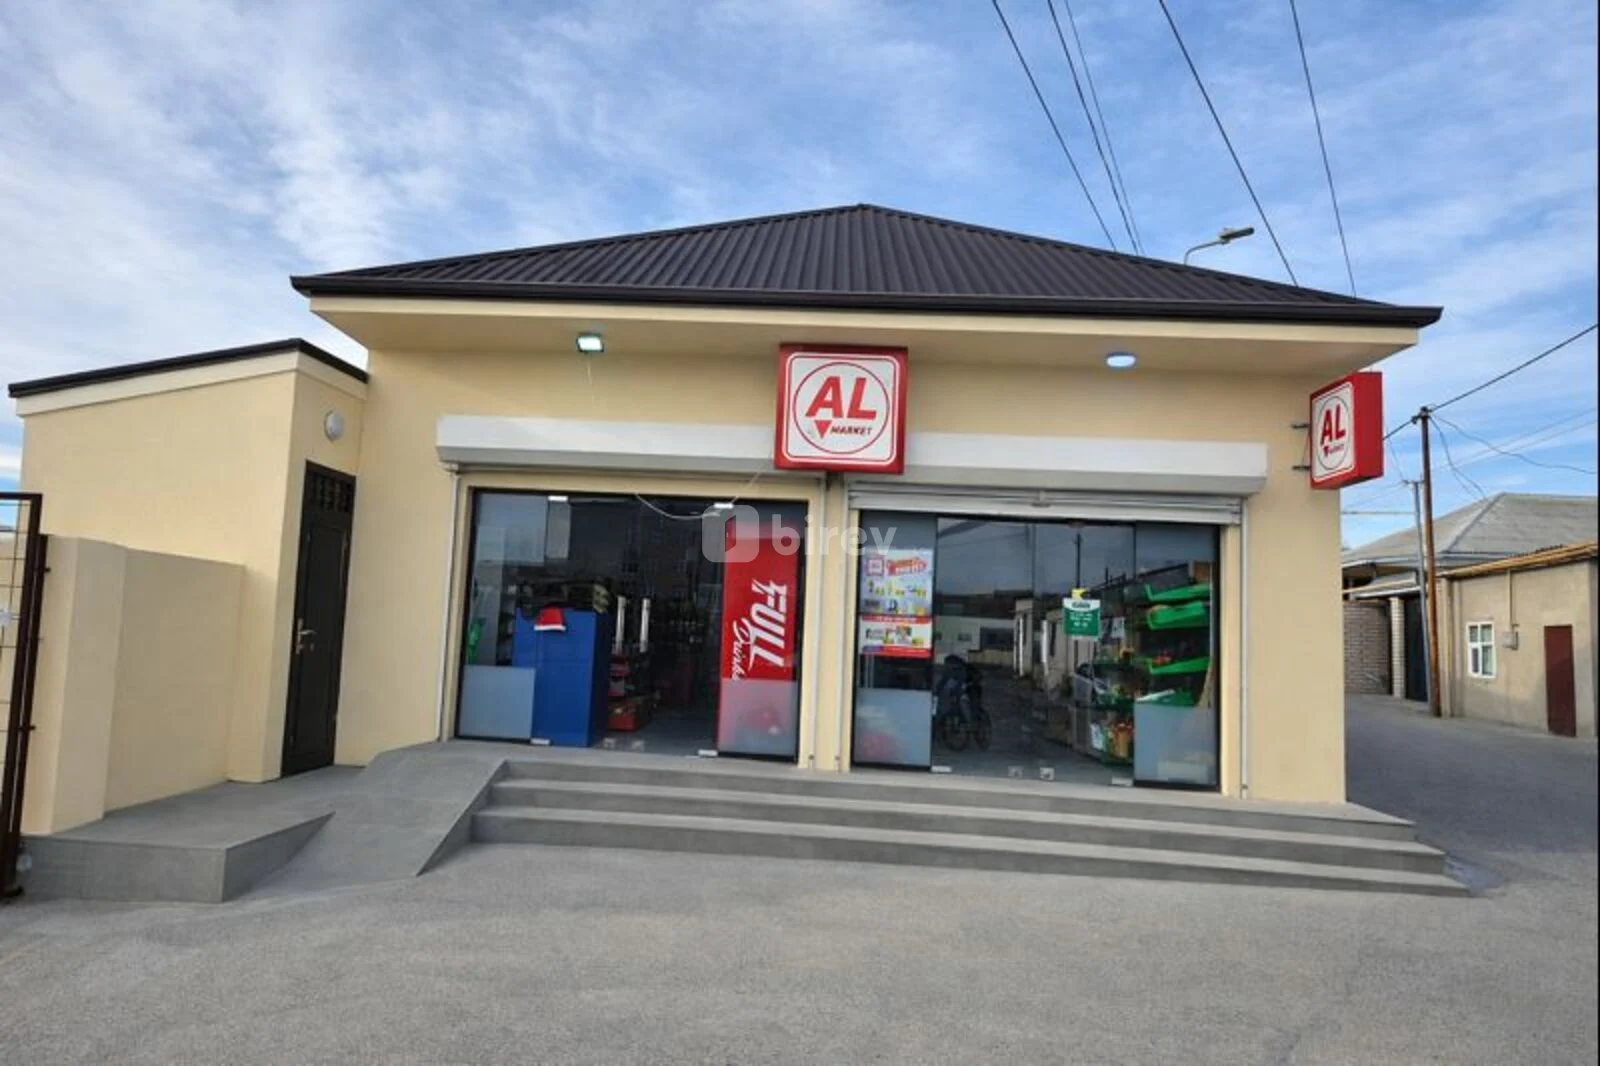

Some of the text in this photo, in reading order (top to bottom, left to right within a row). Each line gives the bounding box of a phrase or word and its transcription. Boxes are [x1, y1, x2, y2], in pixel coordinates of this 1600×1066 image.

[805, 375, 877, 420] AL
[831, 425, 873, 437] MARKET
[1320, 403, 1346, 446] AL
[750, 578, 788, 672] FULL
